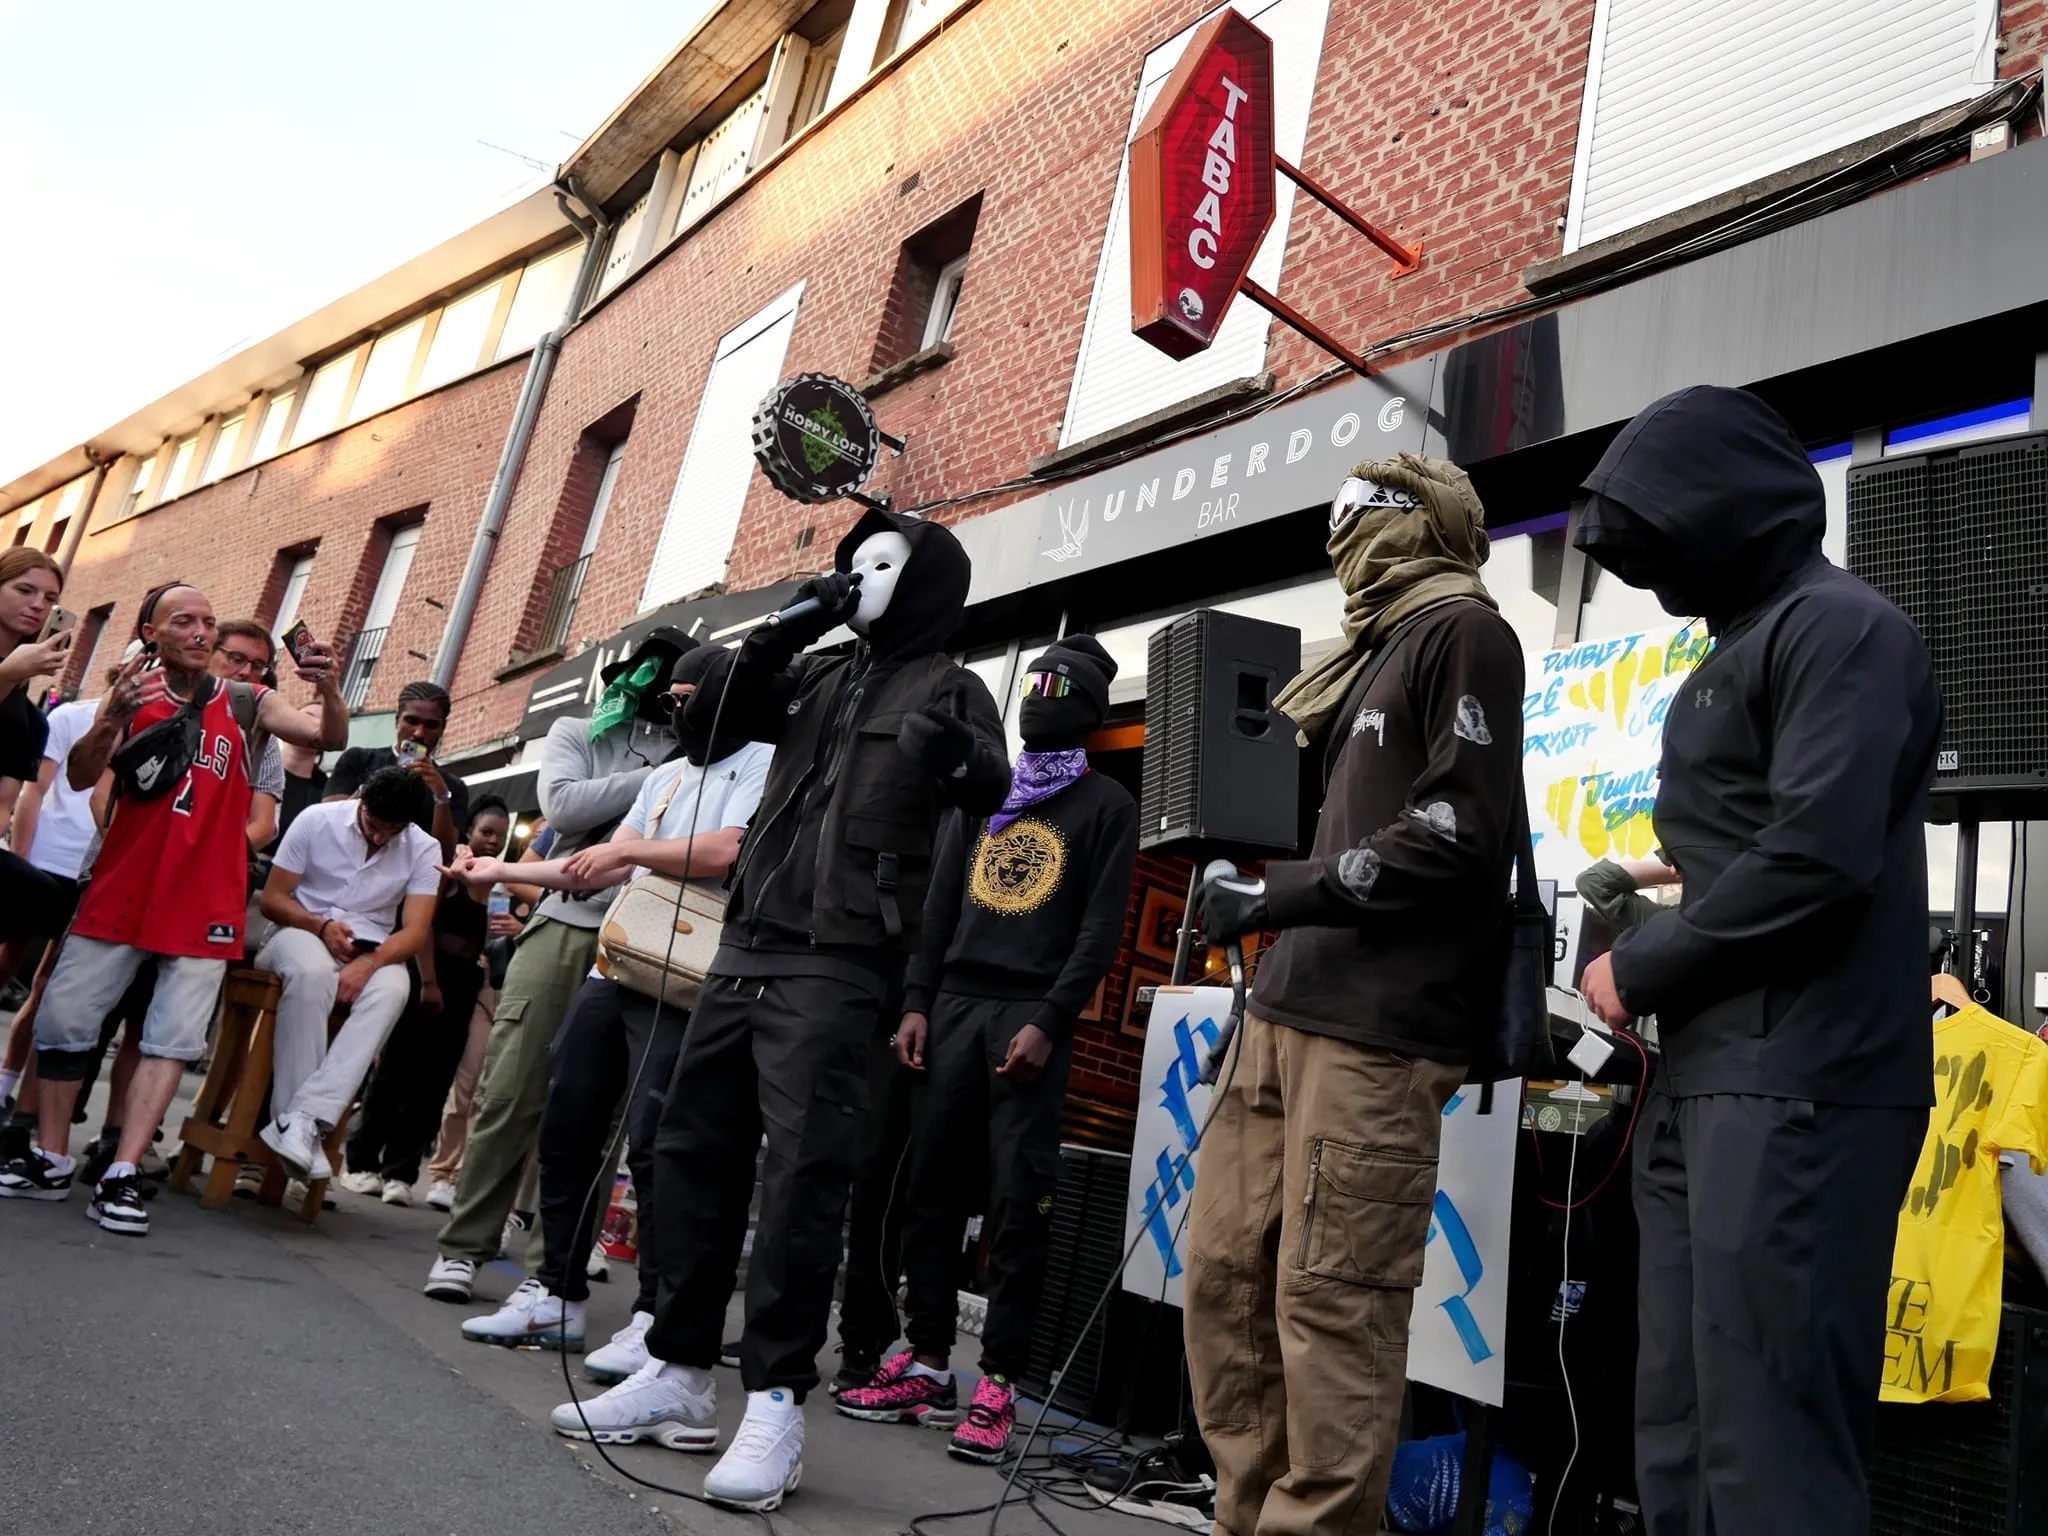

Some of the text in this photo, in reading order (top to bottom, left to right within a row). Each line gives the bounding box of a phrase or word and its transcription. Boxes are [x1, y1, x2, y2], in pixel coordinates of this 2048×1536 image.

[1187, 76, 1249, 270] TABAC
[784, 407, 865, 457] HOPPY LOFT
[1103, 396, 1406, 522] UNDERDOG
[1197, 493, 1240, 529] BAR
[193, 729, 232, 780] LS
[1940, 752, 1956, 765] HK
[1881, 1330, 1960, 1395] EM
